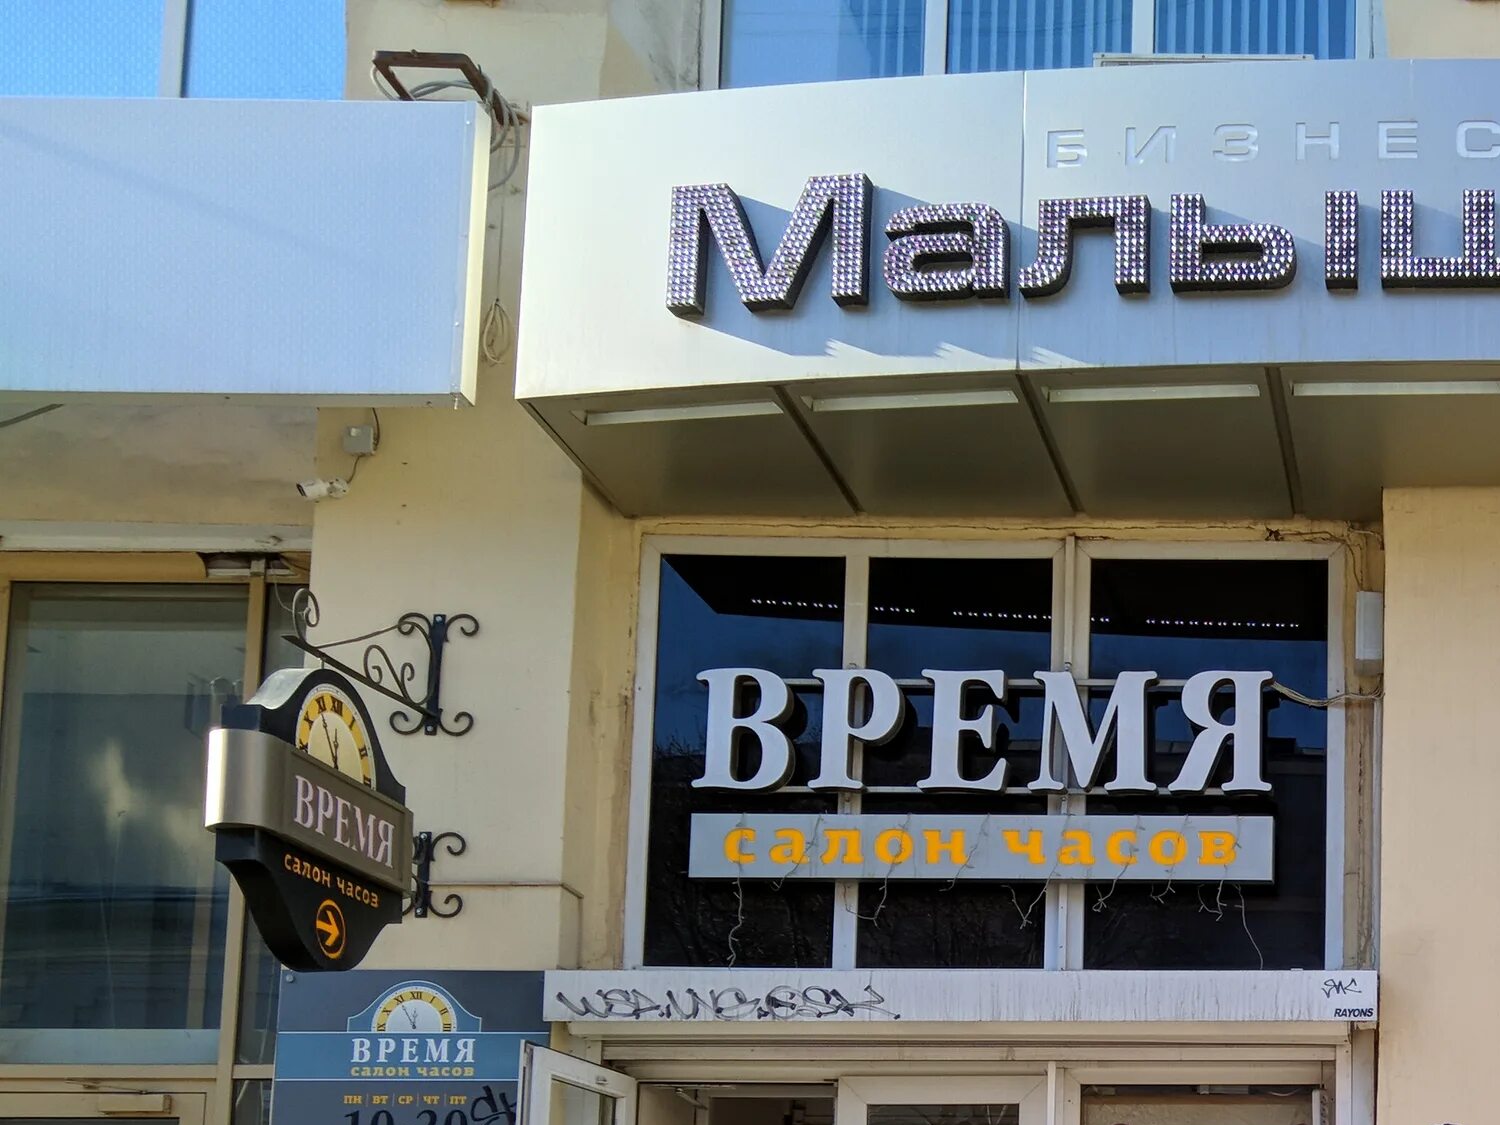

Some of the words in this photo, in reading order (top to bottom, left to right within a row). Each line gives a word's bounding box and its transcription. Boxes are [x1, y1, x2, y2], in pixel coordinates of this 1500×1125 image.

[691, 667, 1275, 795] ВРЕМЯ
[293, 775, 395, 869] ВРЕМЯ
[723, 827, 968, 866] салон
[1002, 828, 1240, 867] часов
[284, 853, 331, 888] салон
[1334, 1007, 1375, 1018] RAYONS
[350, 1037, 477, 1063] ВРЕМЯ
[350, 1066, 410, 1077] салон
[416, 1066, 475, 1077] часов
[343, 1095, 362, 1105] ПН
[372, 1095, 388, 1105] ВТ
[397, 1095, 414, 1105] СР
[423, 1095, 440, 1105] ЧТ
[449, 1095, 468, 1105] ПТ
